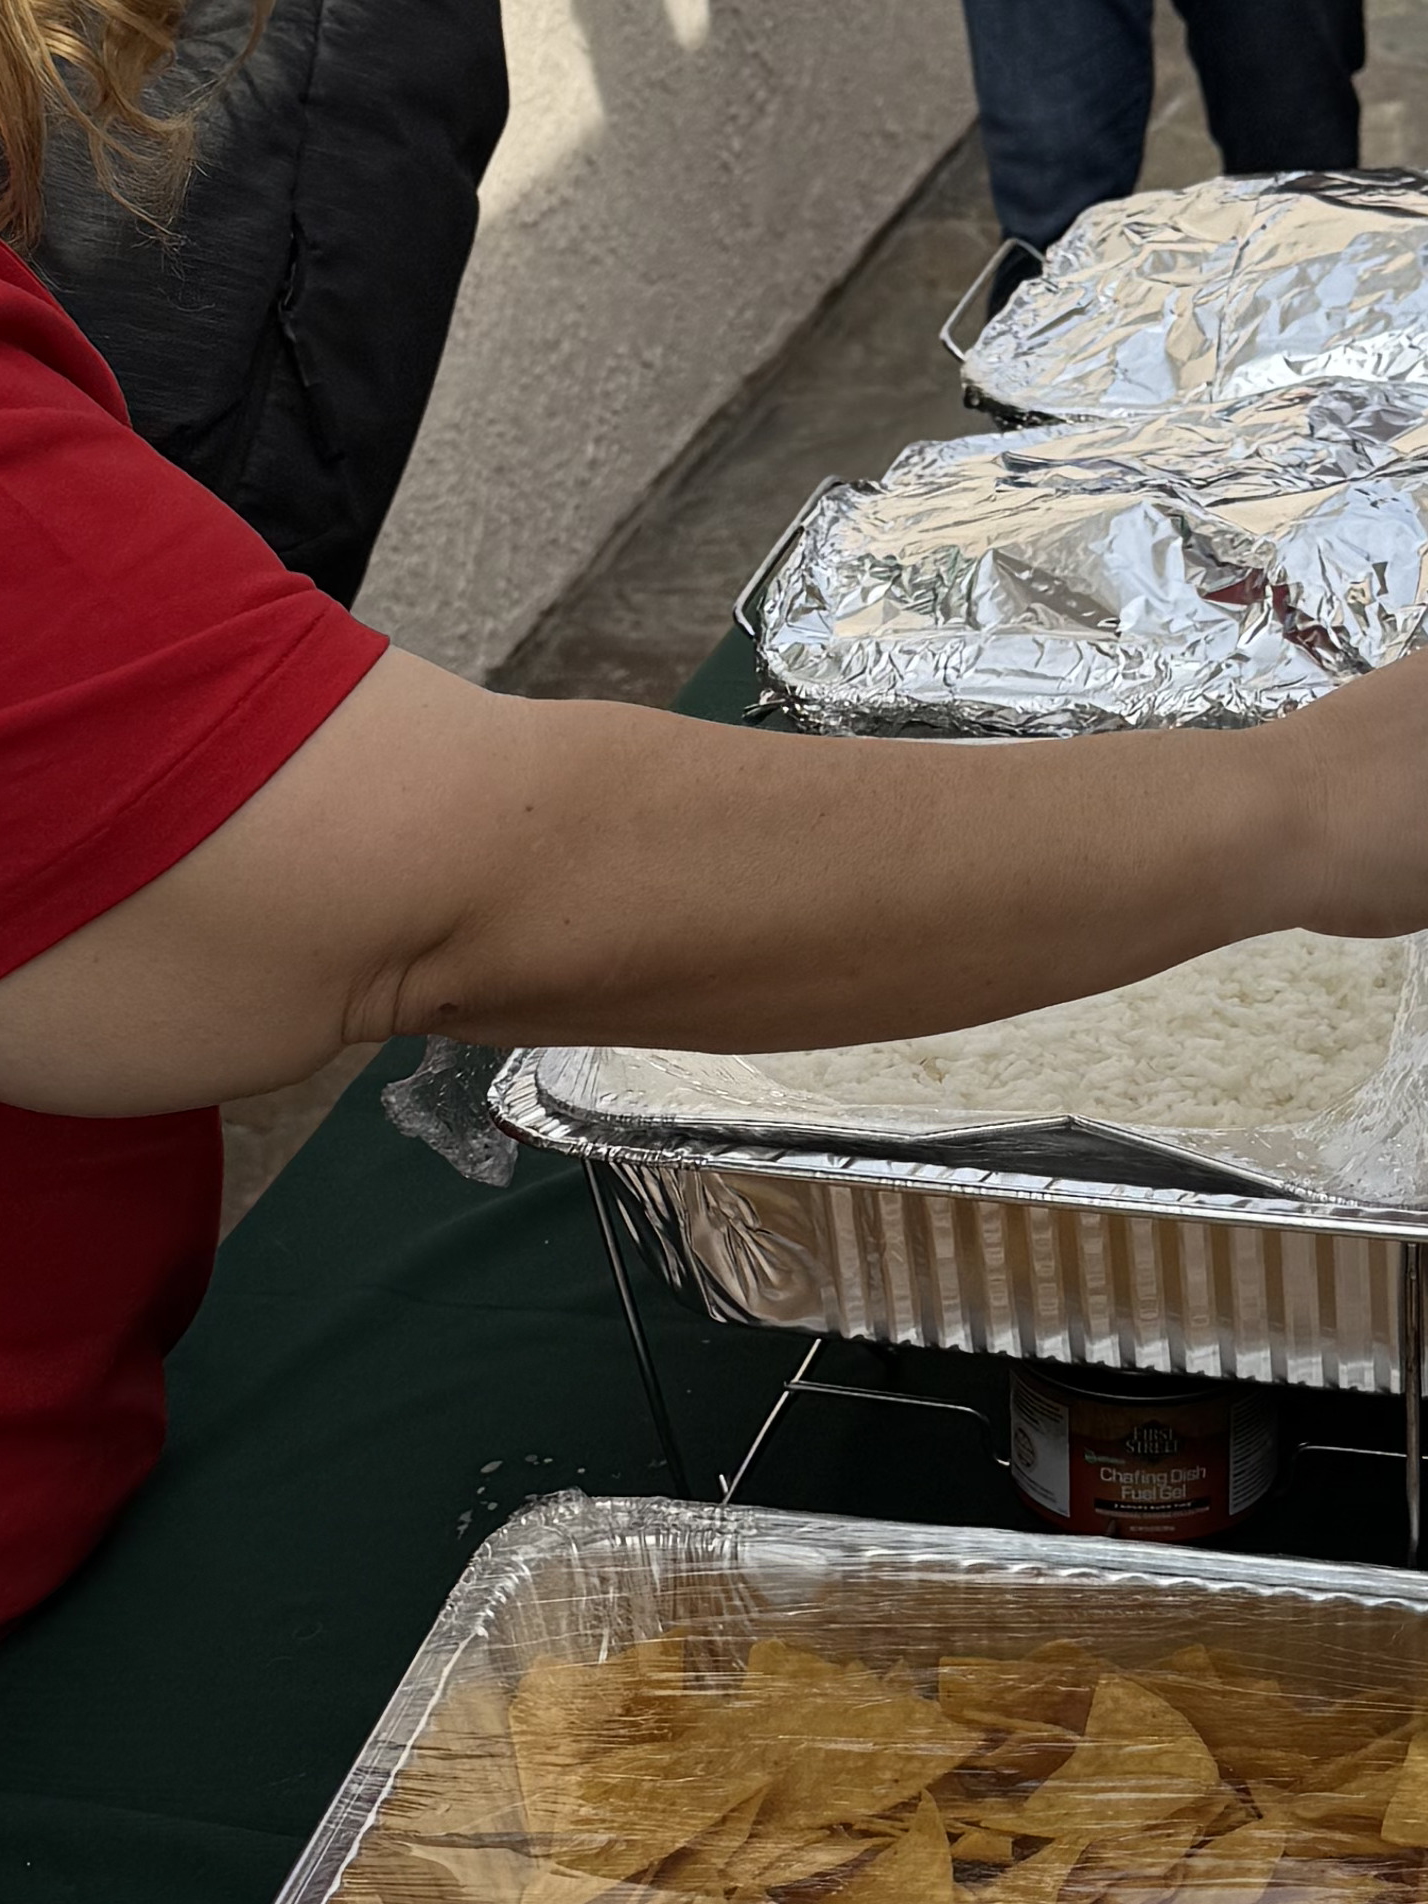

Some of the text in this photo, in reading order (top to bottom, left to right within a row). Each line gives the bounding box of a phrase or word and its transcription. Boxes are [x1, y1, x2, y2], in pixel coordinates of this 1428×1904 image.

[1133, 1425, 1173, 1441] FIRST
[1124, 1439, 1180, 1455] STREET
[1099, 1464, 1207, 1487] Chafing Dish
[1121, 1483, 1187, 1501] Fuel Gel
